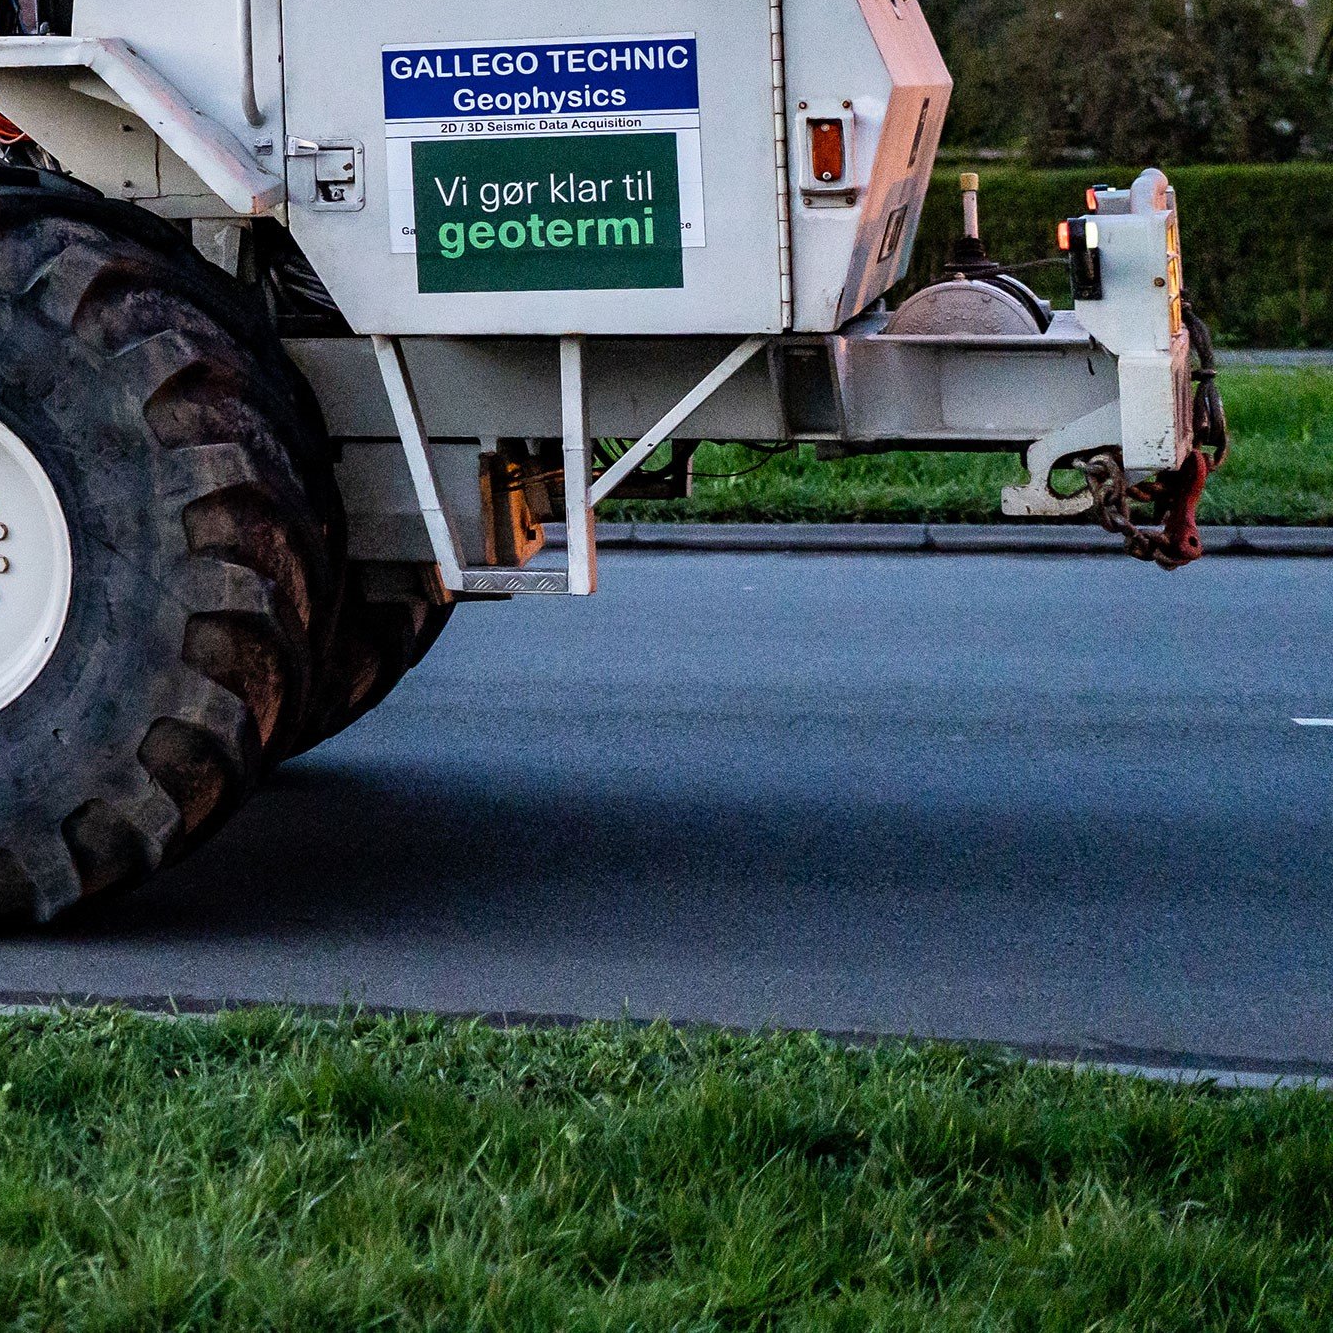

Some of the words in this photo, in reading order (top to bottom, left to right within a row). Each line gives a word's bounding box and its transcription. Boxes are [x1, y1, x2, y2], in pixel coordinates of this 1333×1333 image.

[390, 52, 539, 80] GALLEGO
[546, 45, 689, 74] TECHNIC
[453, 85, 626, 115] Geophysics
[441, 123, 457, 133] 2D
[467, 122, 483, 132] 3D
[487, 121, 536, 132] Seismic
[539, 119, 568, 130] Data
[571, 117, 642, 131] Acquisition
[434, 176, 469, 207] Vi
[479, 179, 539, 213] gør
[549, 173, 613, 204] klar
[622, 170, 653, 201] til
[438, 207, 655, 259] geotermi
